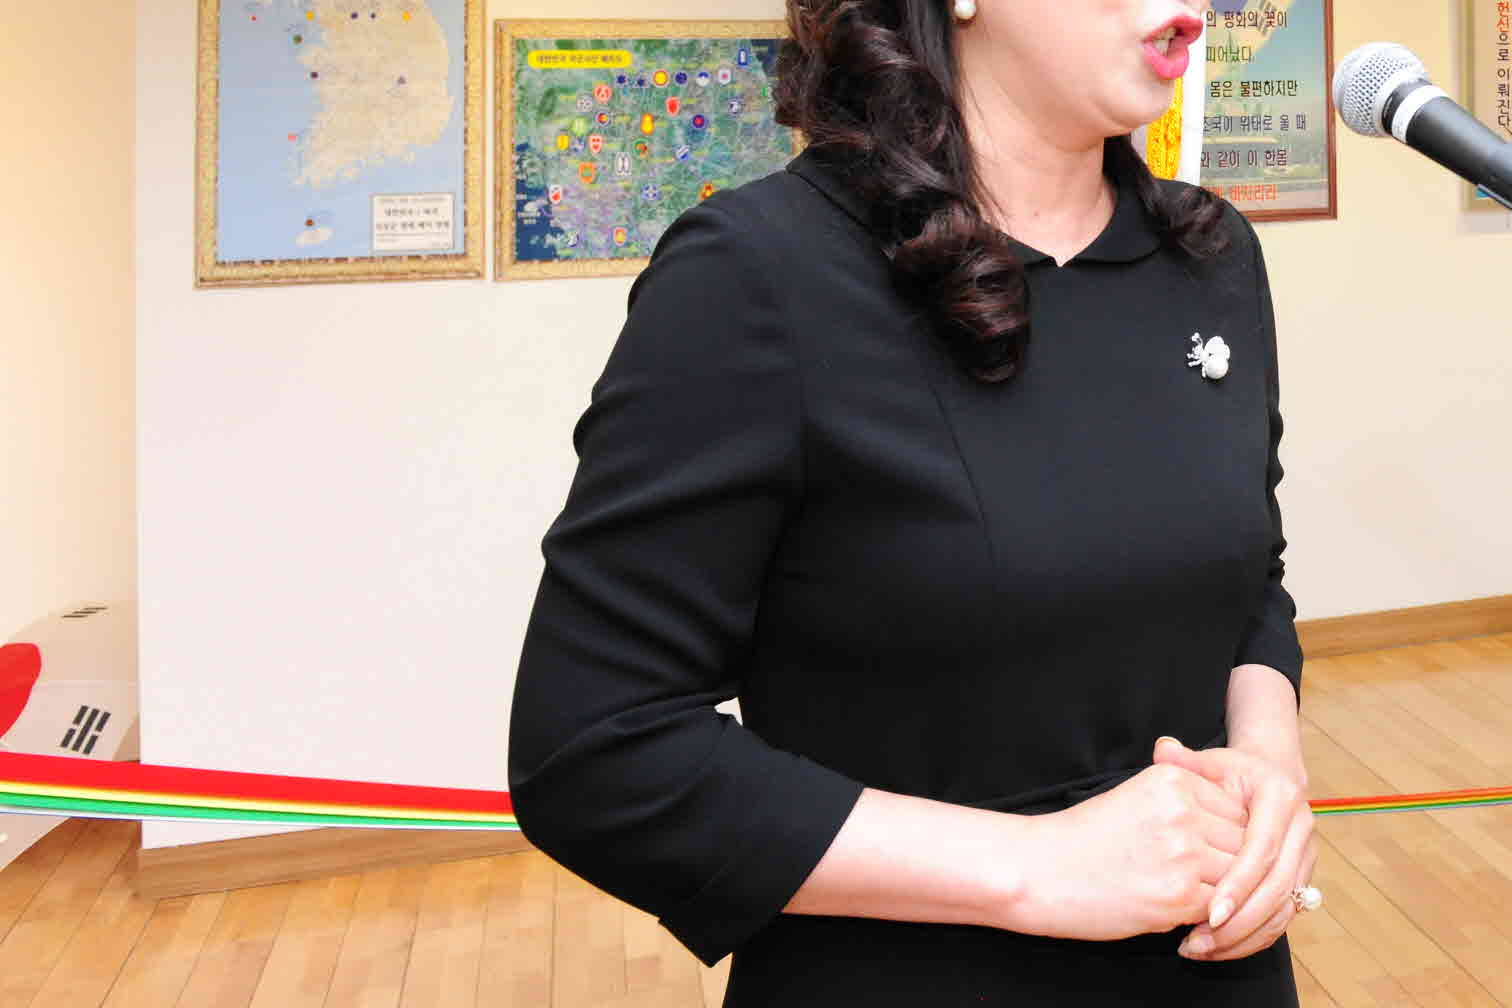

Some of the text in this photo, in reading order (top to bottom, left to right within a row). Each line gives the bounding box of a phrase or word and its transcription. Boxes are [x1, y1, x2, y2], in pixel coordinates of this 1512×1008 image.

[1223, 10, 1259, 29] 평화의
[1264, 10, 1288, 29] 꽃이
[1210, 79, 1298, 98] 몸은 불편하지만
